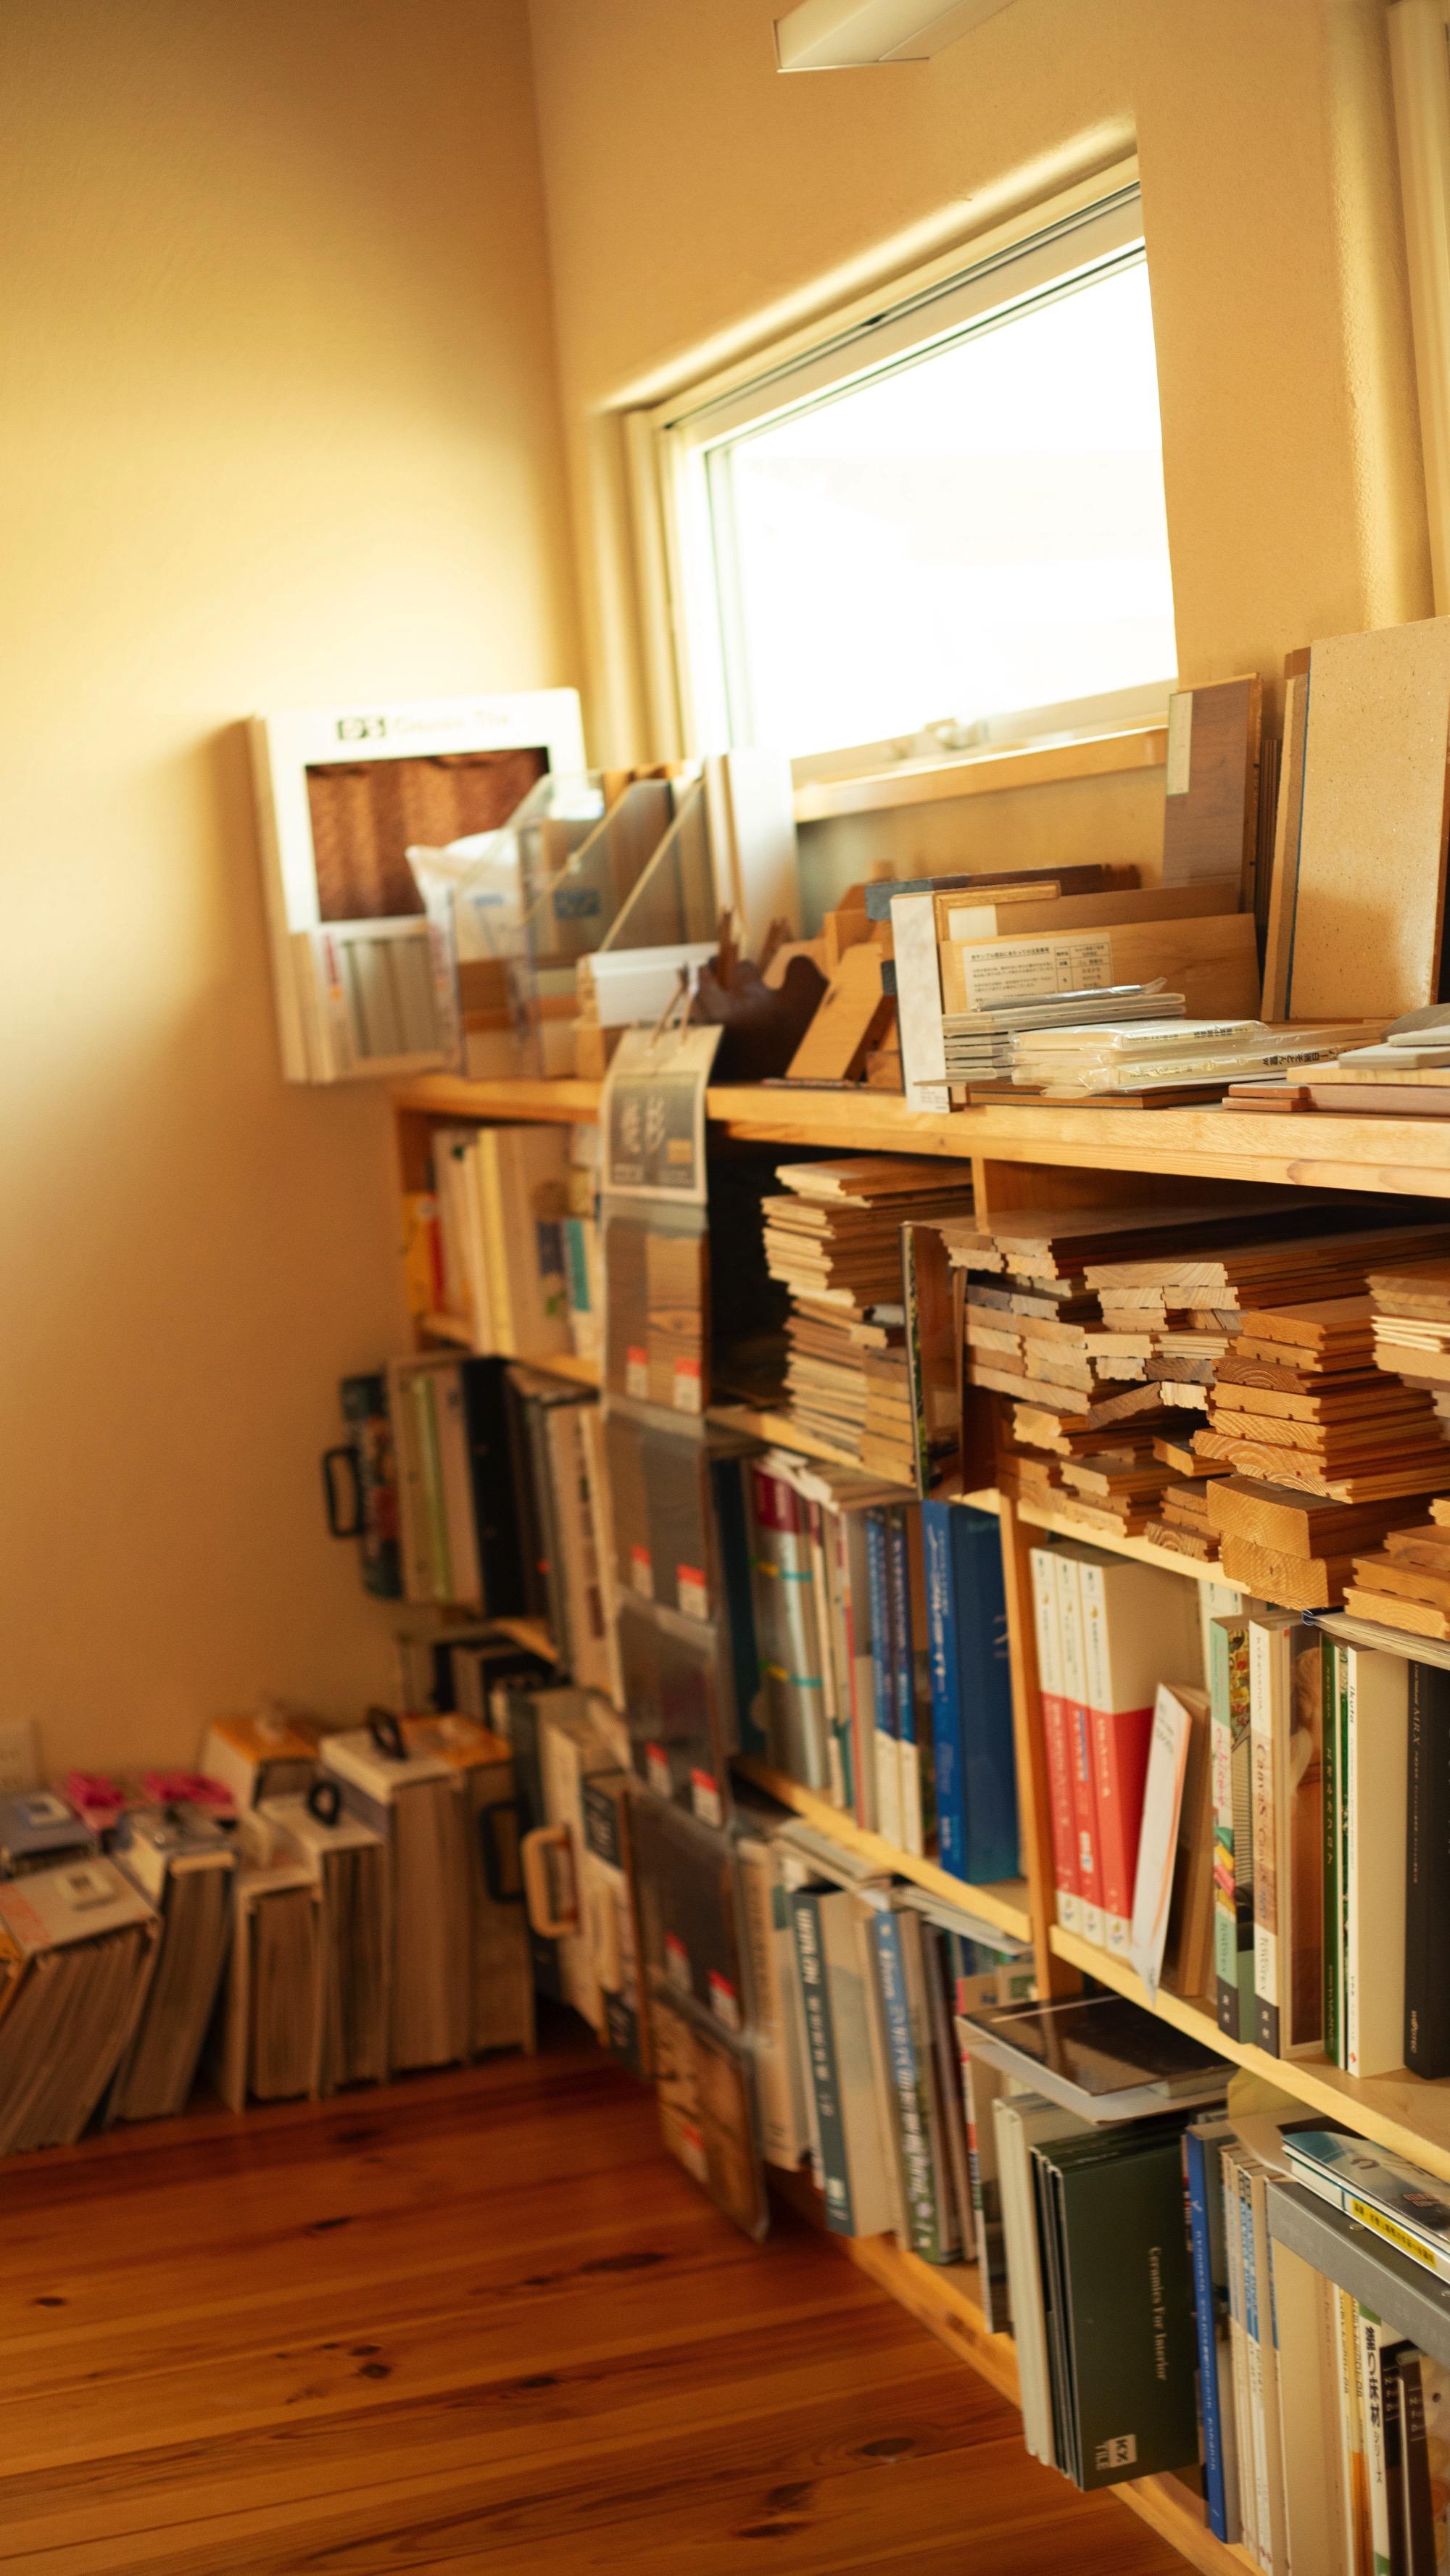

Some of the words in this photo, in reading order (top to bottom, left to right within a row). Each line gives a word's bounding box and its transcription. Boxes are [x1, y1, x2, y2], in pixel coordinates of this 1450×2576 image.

[1148, 2247, 1164, 2304] Ceramics
[1152, 2306, 1165, 2330] For
[1154, 2333, 1169, 2381] Interior
